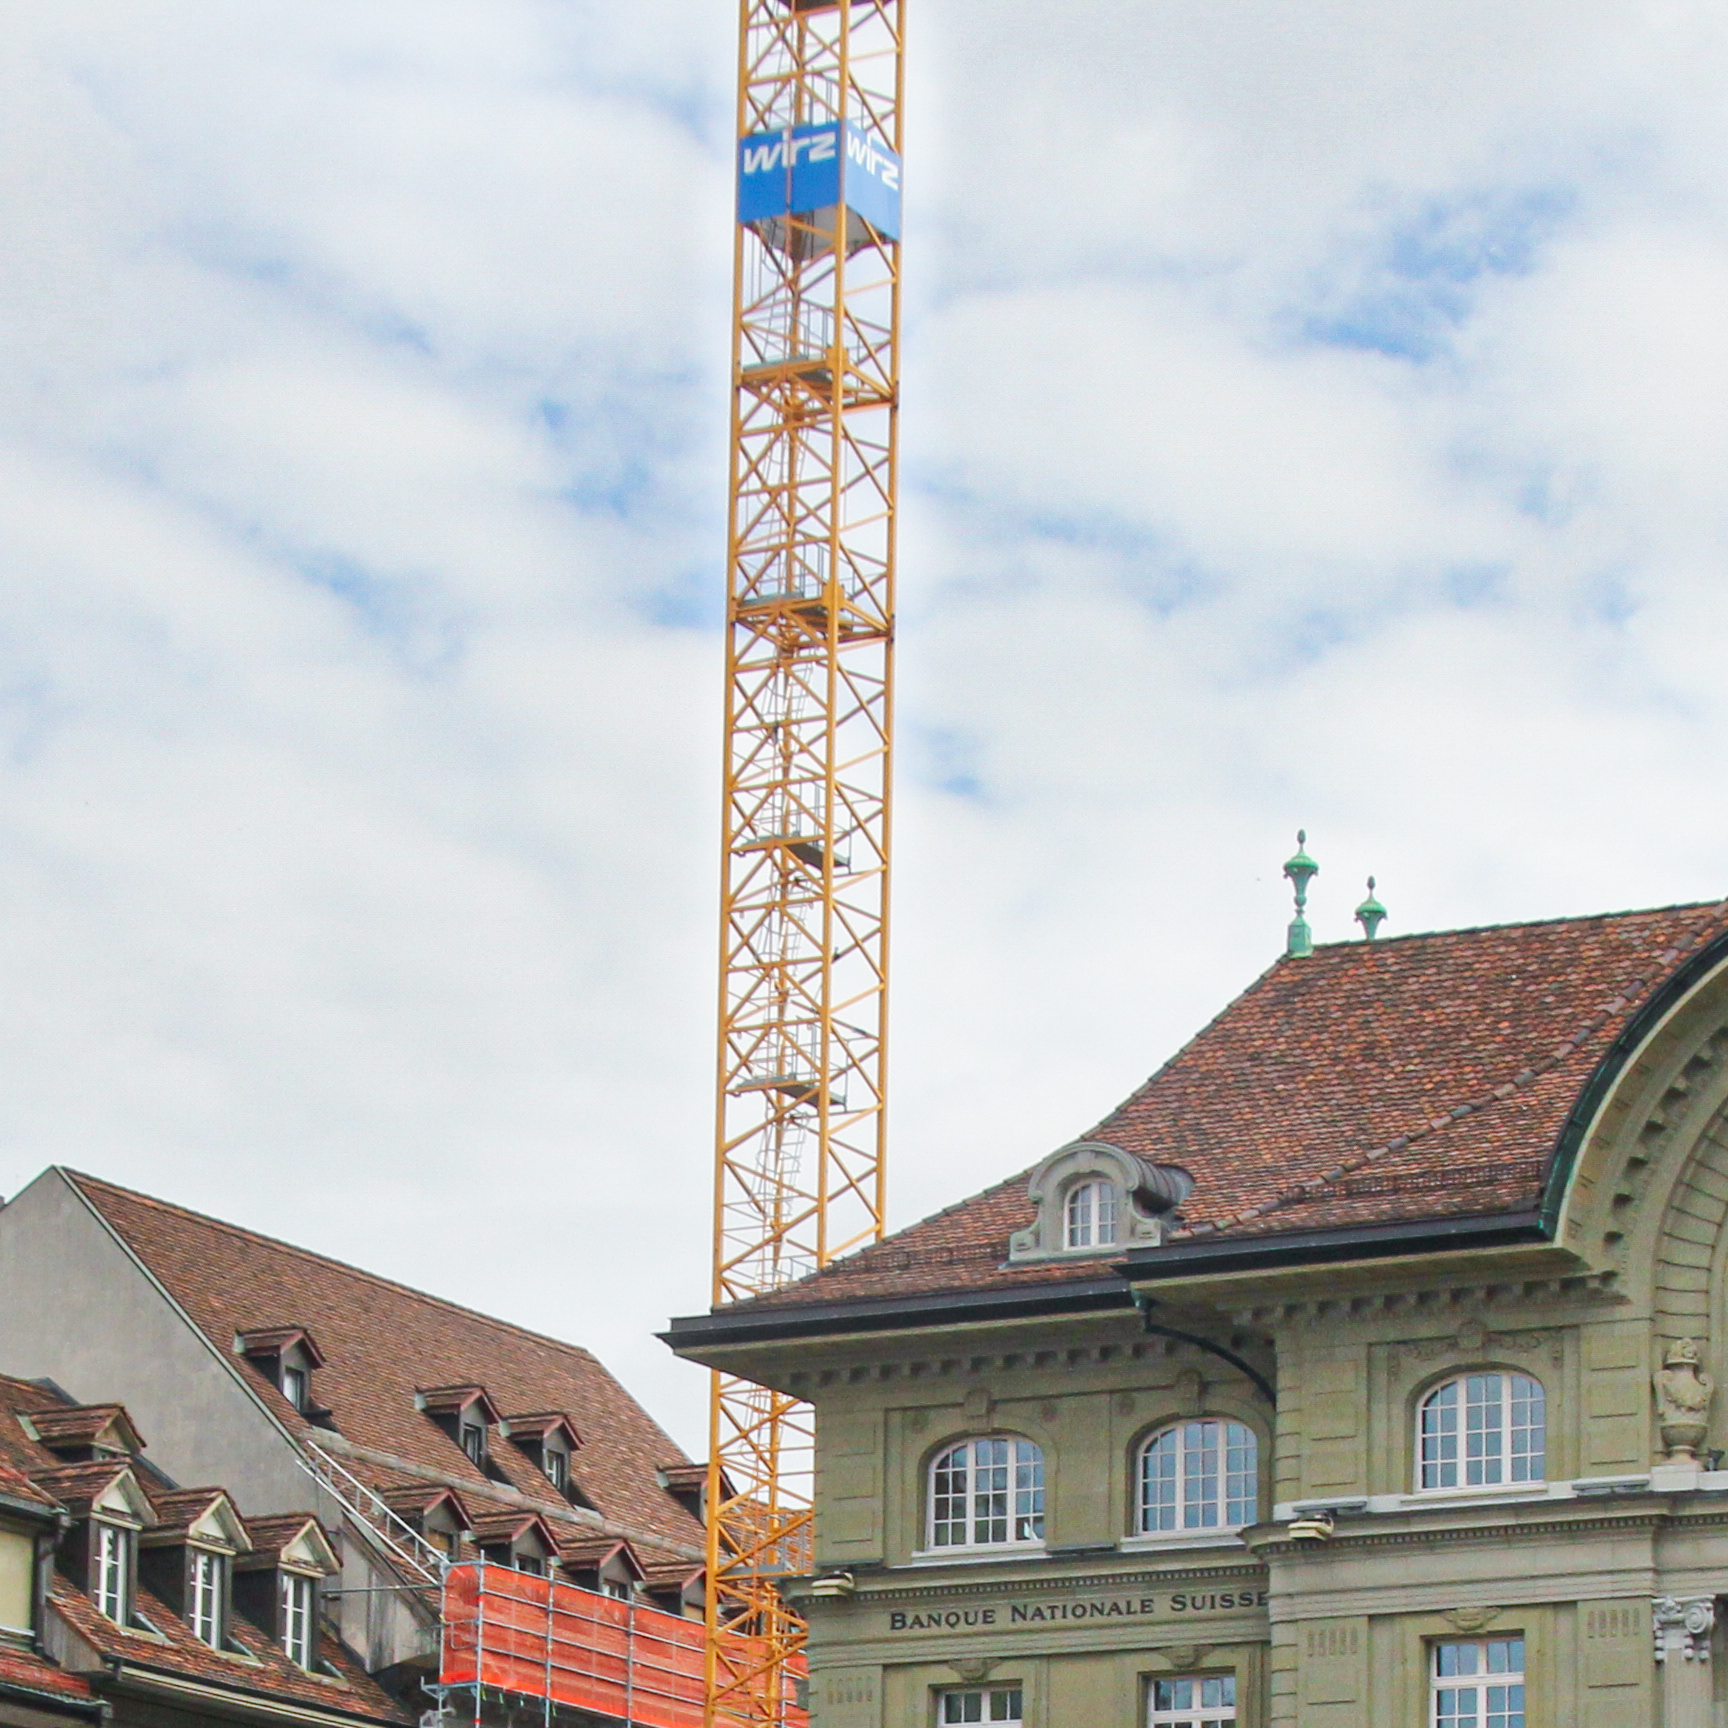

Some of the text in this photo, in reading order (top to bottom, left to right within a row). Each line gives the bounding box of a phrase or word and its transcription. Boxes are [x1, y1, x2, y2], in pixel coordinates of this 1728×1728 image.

[889, 1590, 1268, 1631] BANQUE NATIONALE SUISSE
